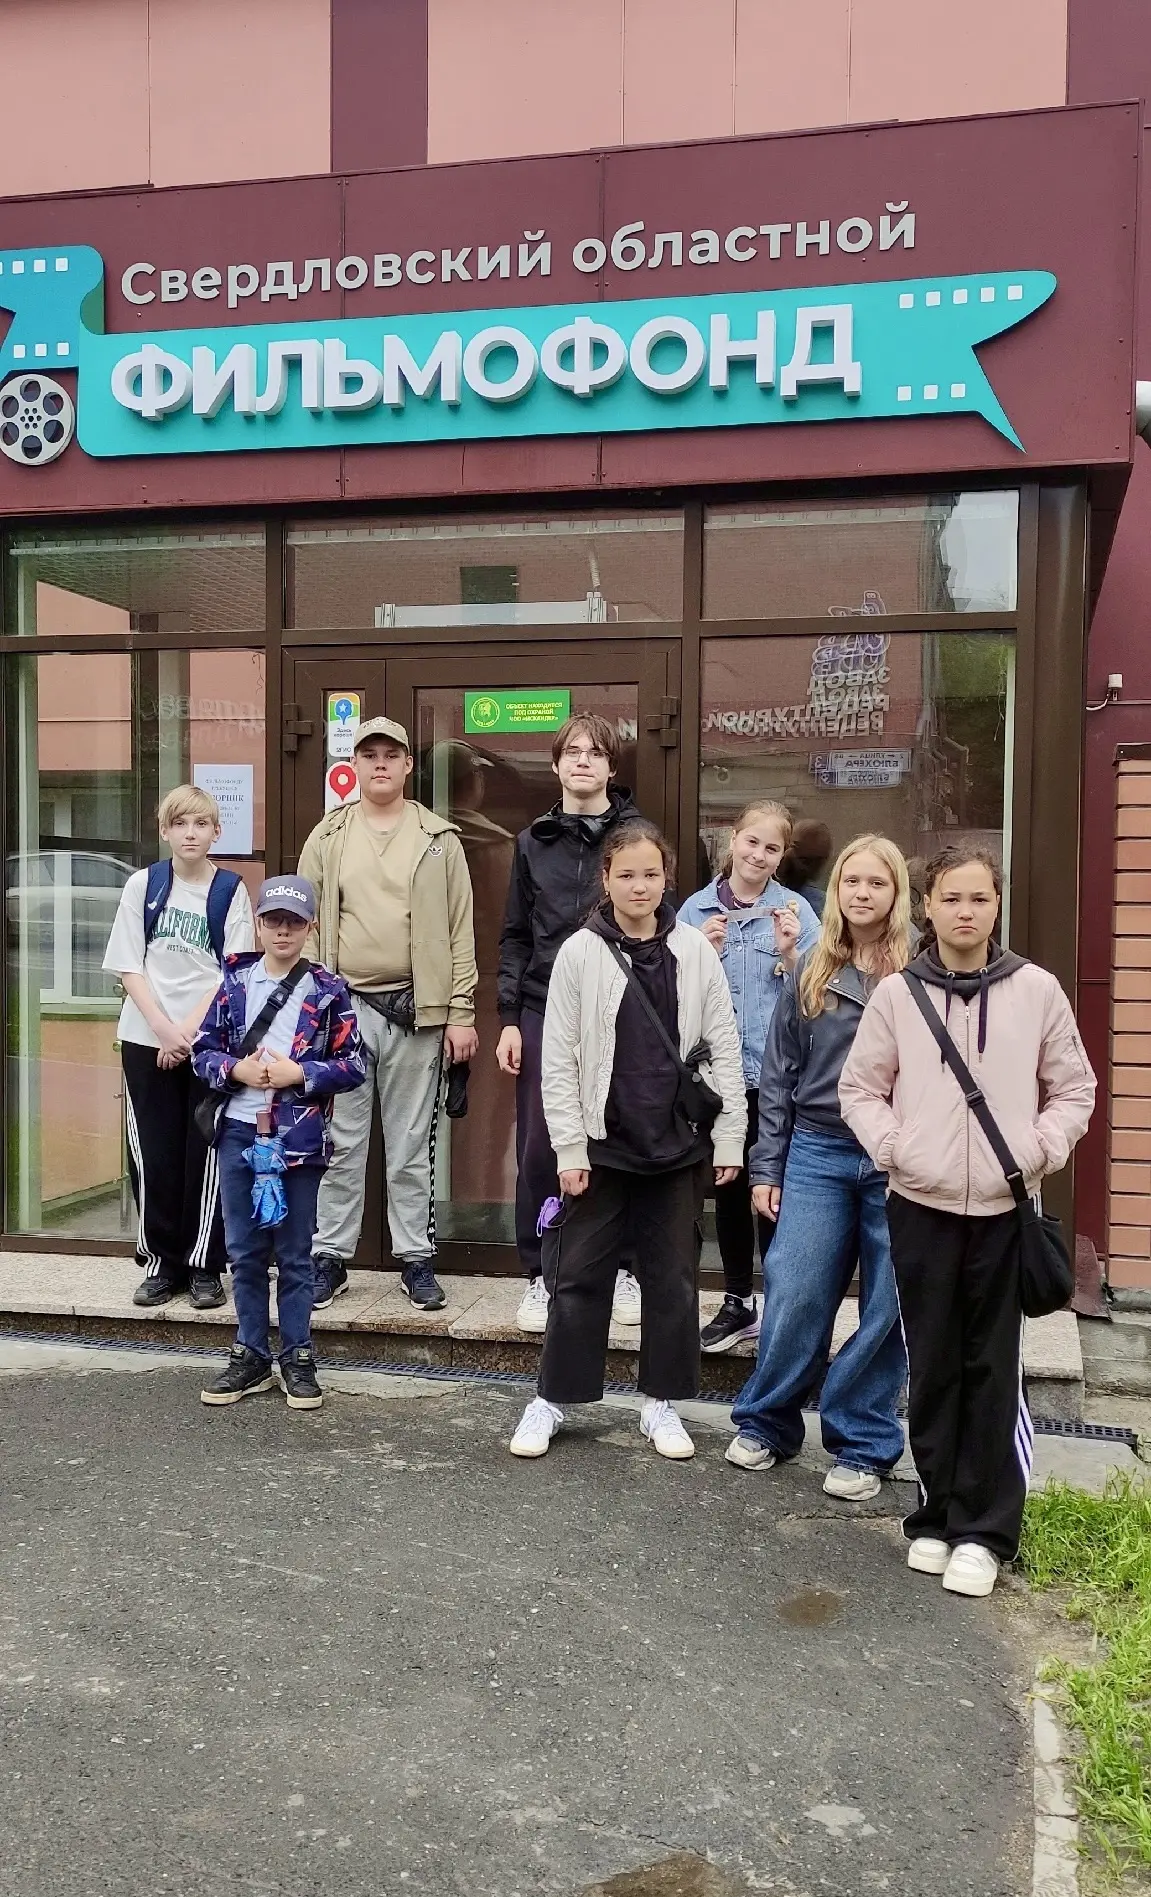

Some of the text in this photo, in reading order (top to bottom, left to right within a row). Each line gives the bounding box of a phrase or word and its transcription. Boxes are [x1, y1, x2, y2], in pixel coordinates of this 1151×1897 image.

[121, 201, 916, 308] Свердловский областной
[111, 304, 862, 421] ФИЛЬМОФОНД
[210, 794, 244, 802] ОРНИК
[266, 885, 308, 903] adidas
